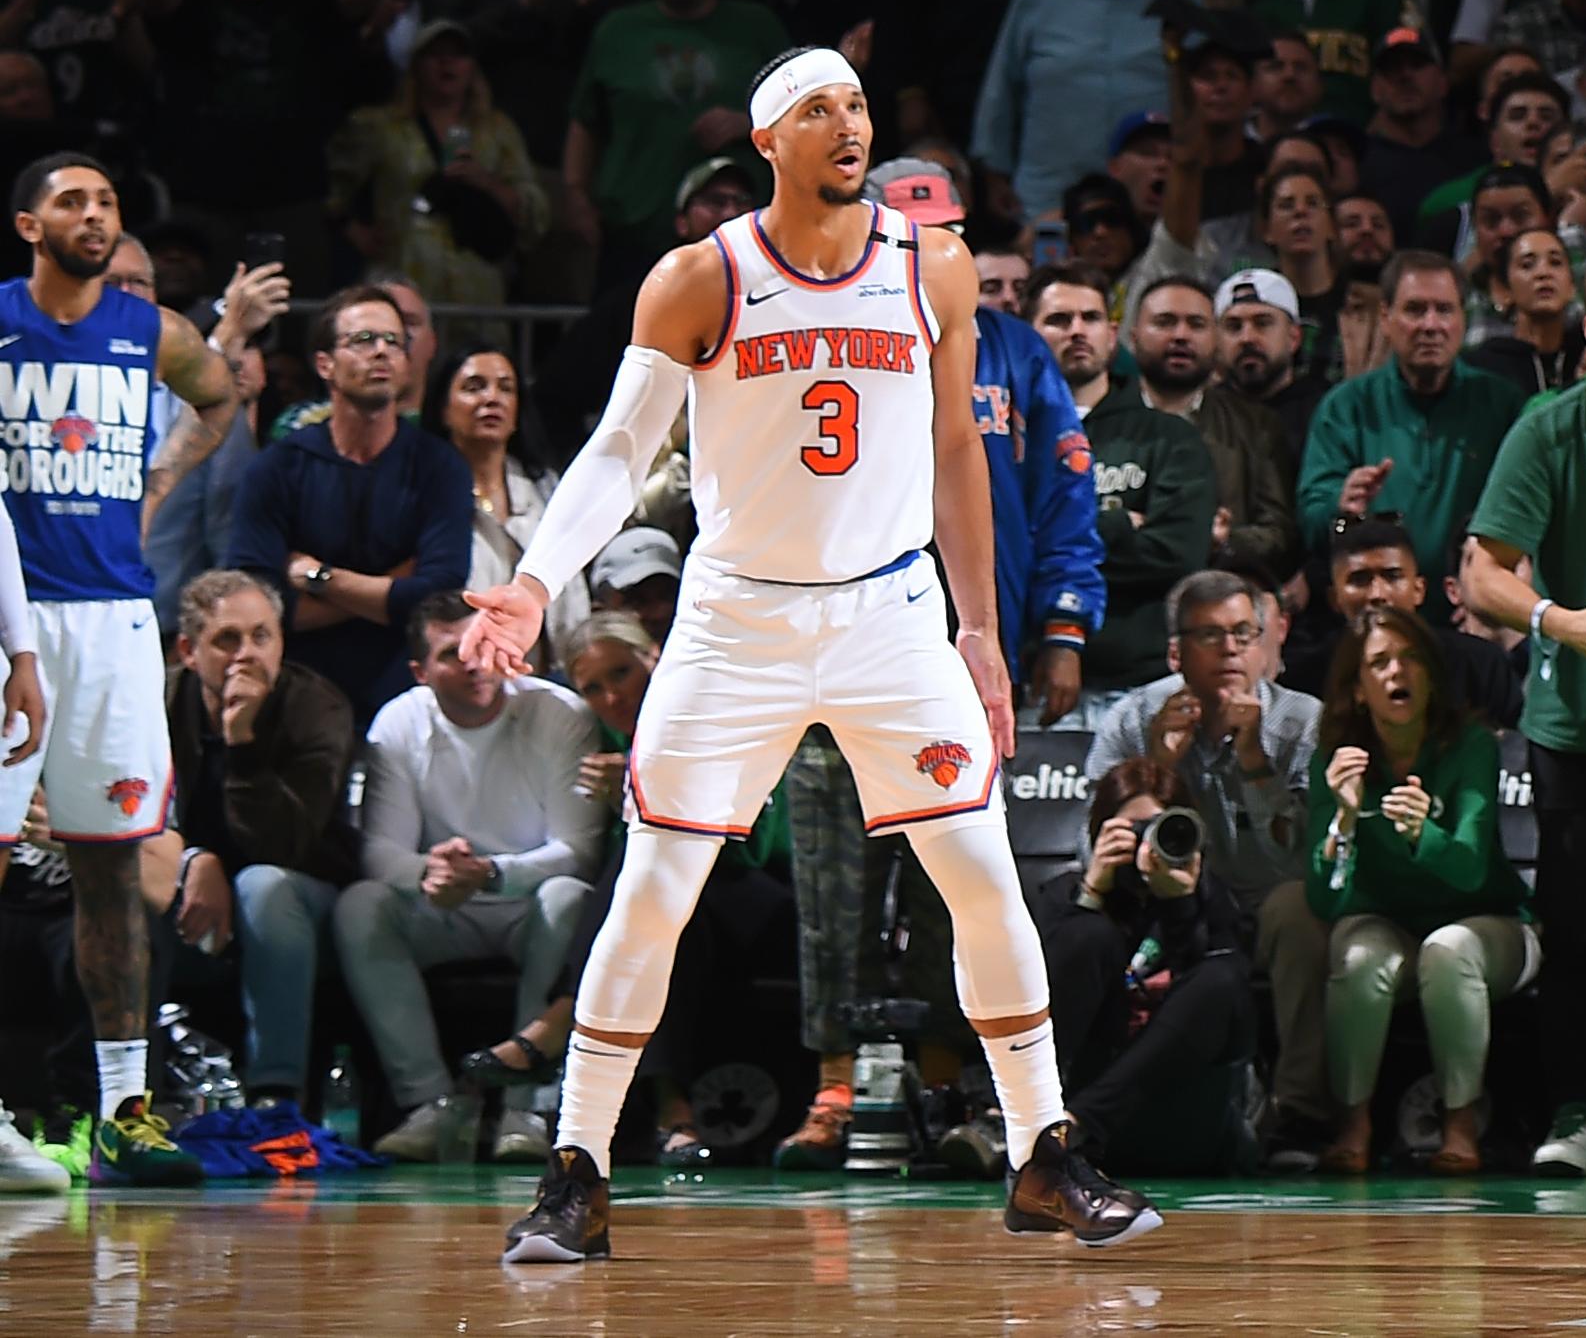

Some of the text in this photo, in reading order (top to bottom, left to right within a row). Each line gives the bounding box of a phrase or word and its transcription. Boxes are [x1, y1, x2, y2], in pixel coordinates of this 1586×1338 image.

[735, 328, 917, 380] NEW YORK
[0, 362, 149, 428] WIN
[98, 425, 144, 454] THE
[801, 381, 859, 475] 3
[1013, 764, 1091, 800] eltic
